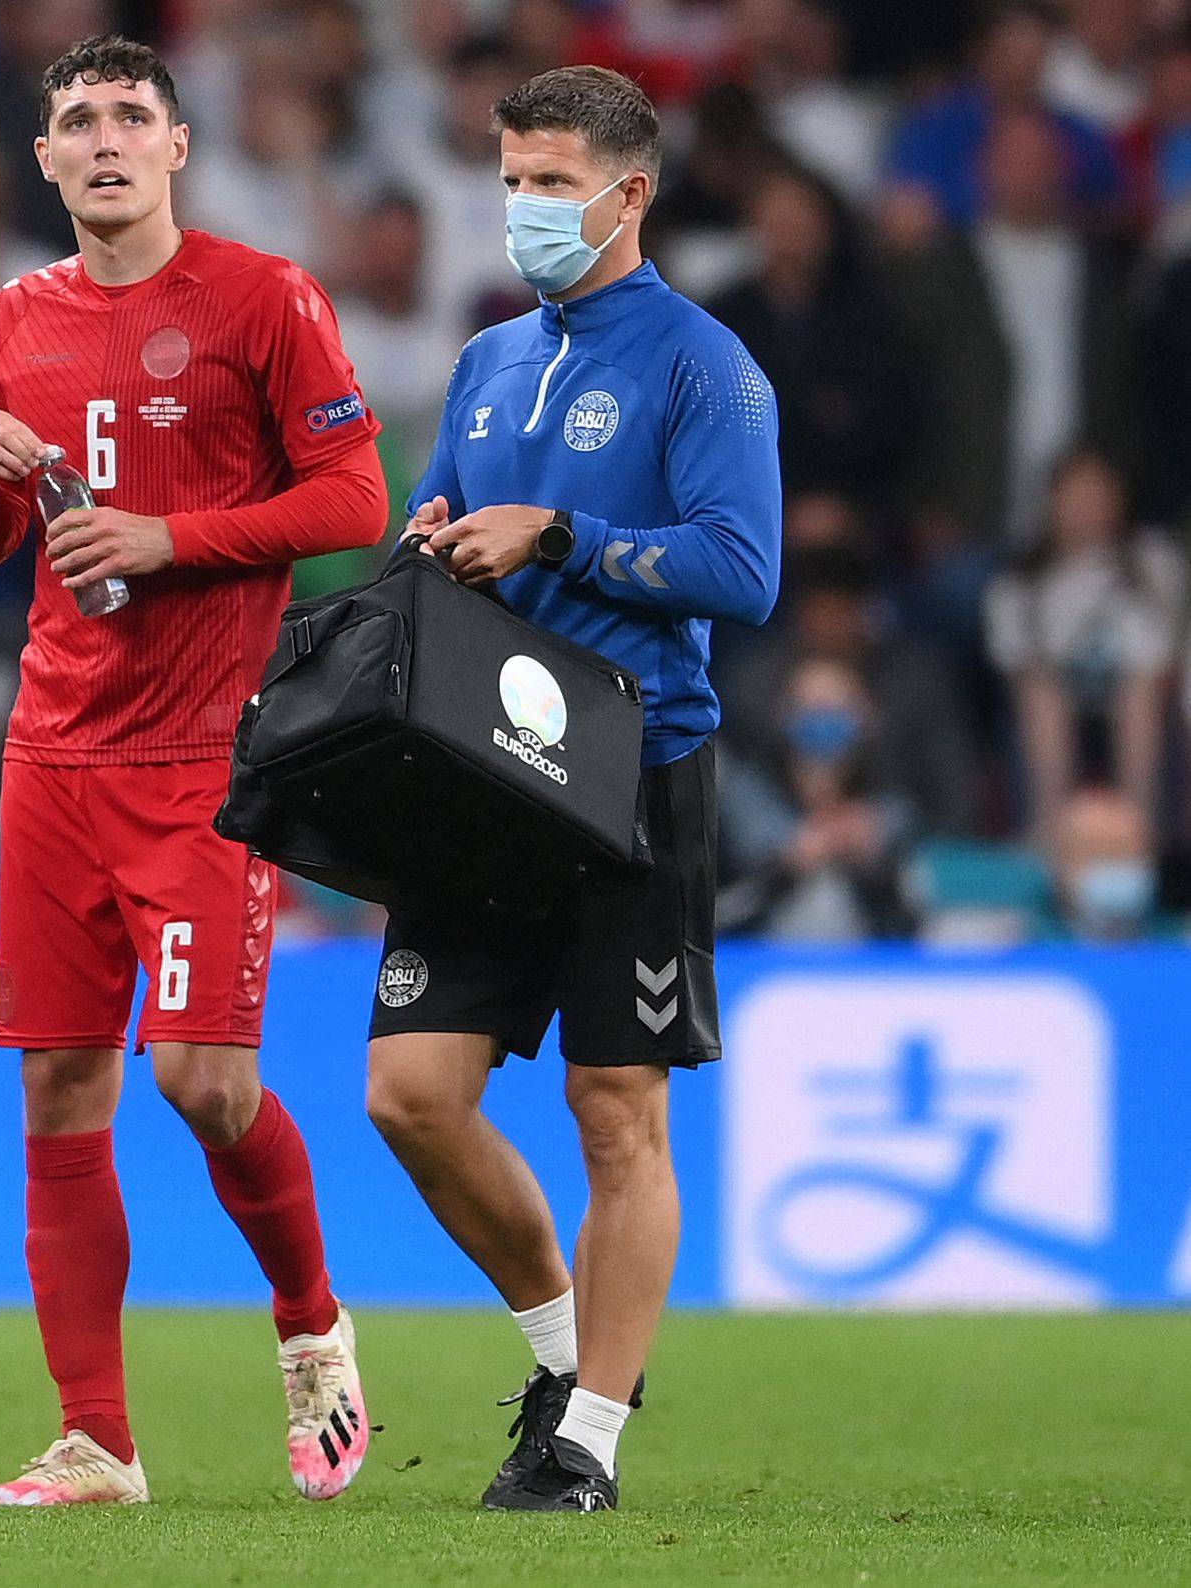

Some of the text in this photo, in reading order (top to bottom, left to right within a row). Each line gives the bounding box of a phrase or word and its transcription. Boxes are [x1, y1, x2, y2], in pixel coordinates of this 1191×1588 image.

[87, 399, 116, 490] 6
[573, 410, 607, 429] DBU
[492, 727, 568, 786] EURO2020
[158, 921, 192, 1011] 6
[386, 968, 416, 986] DBU
